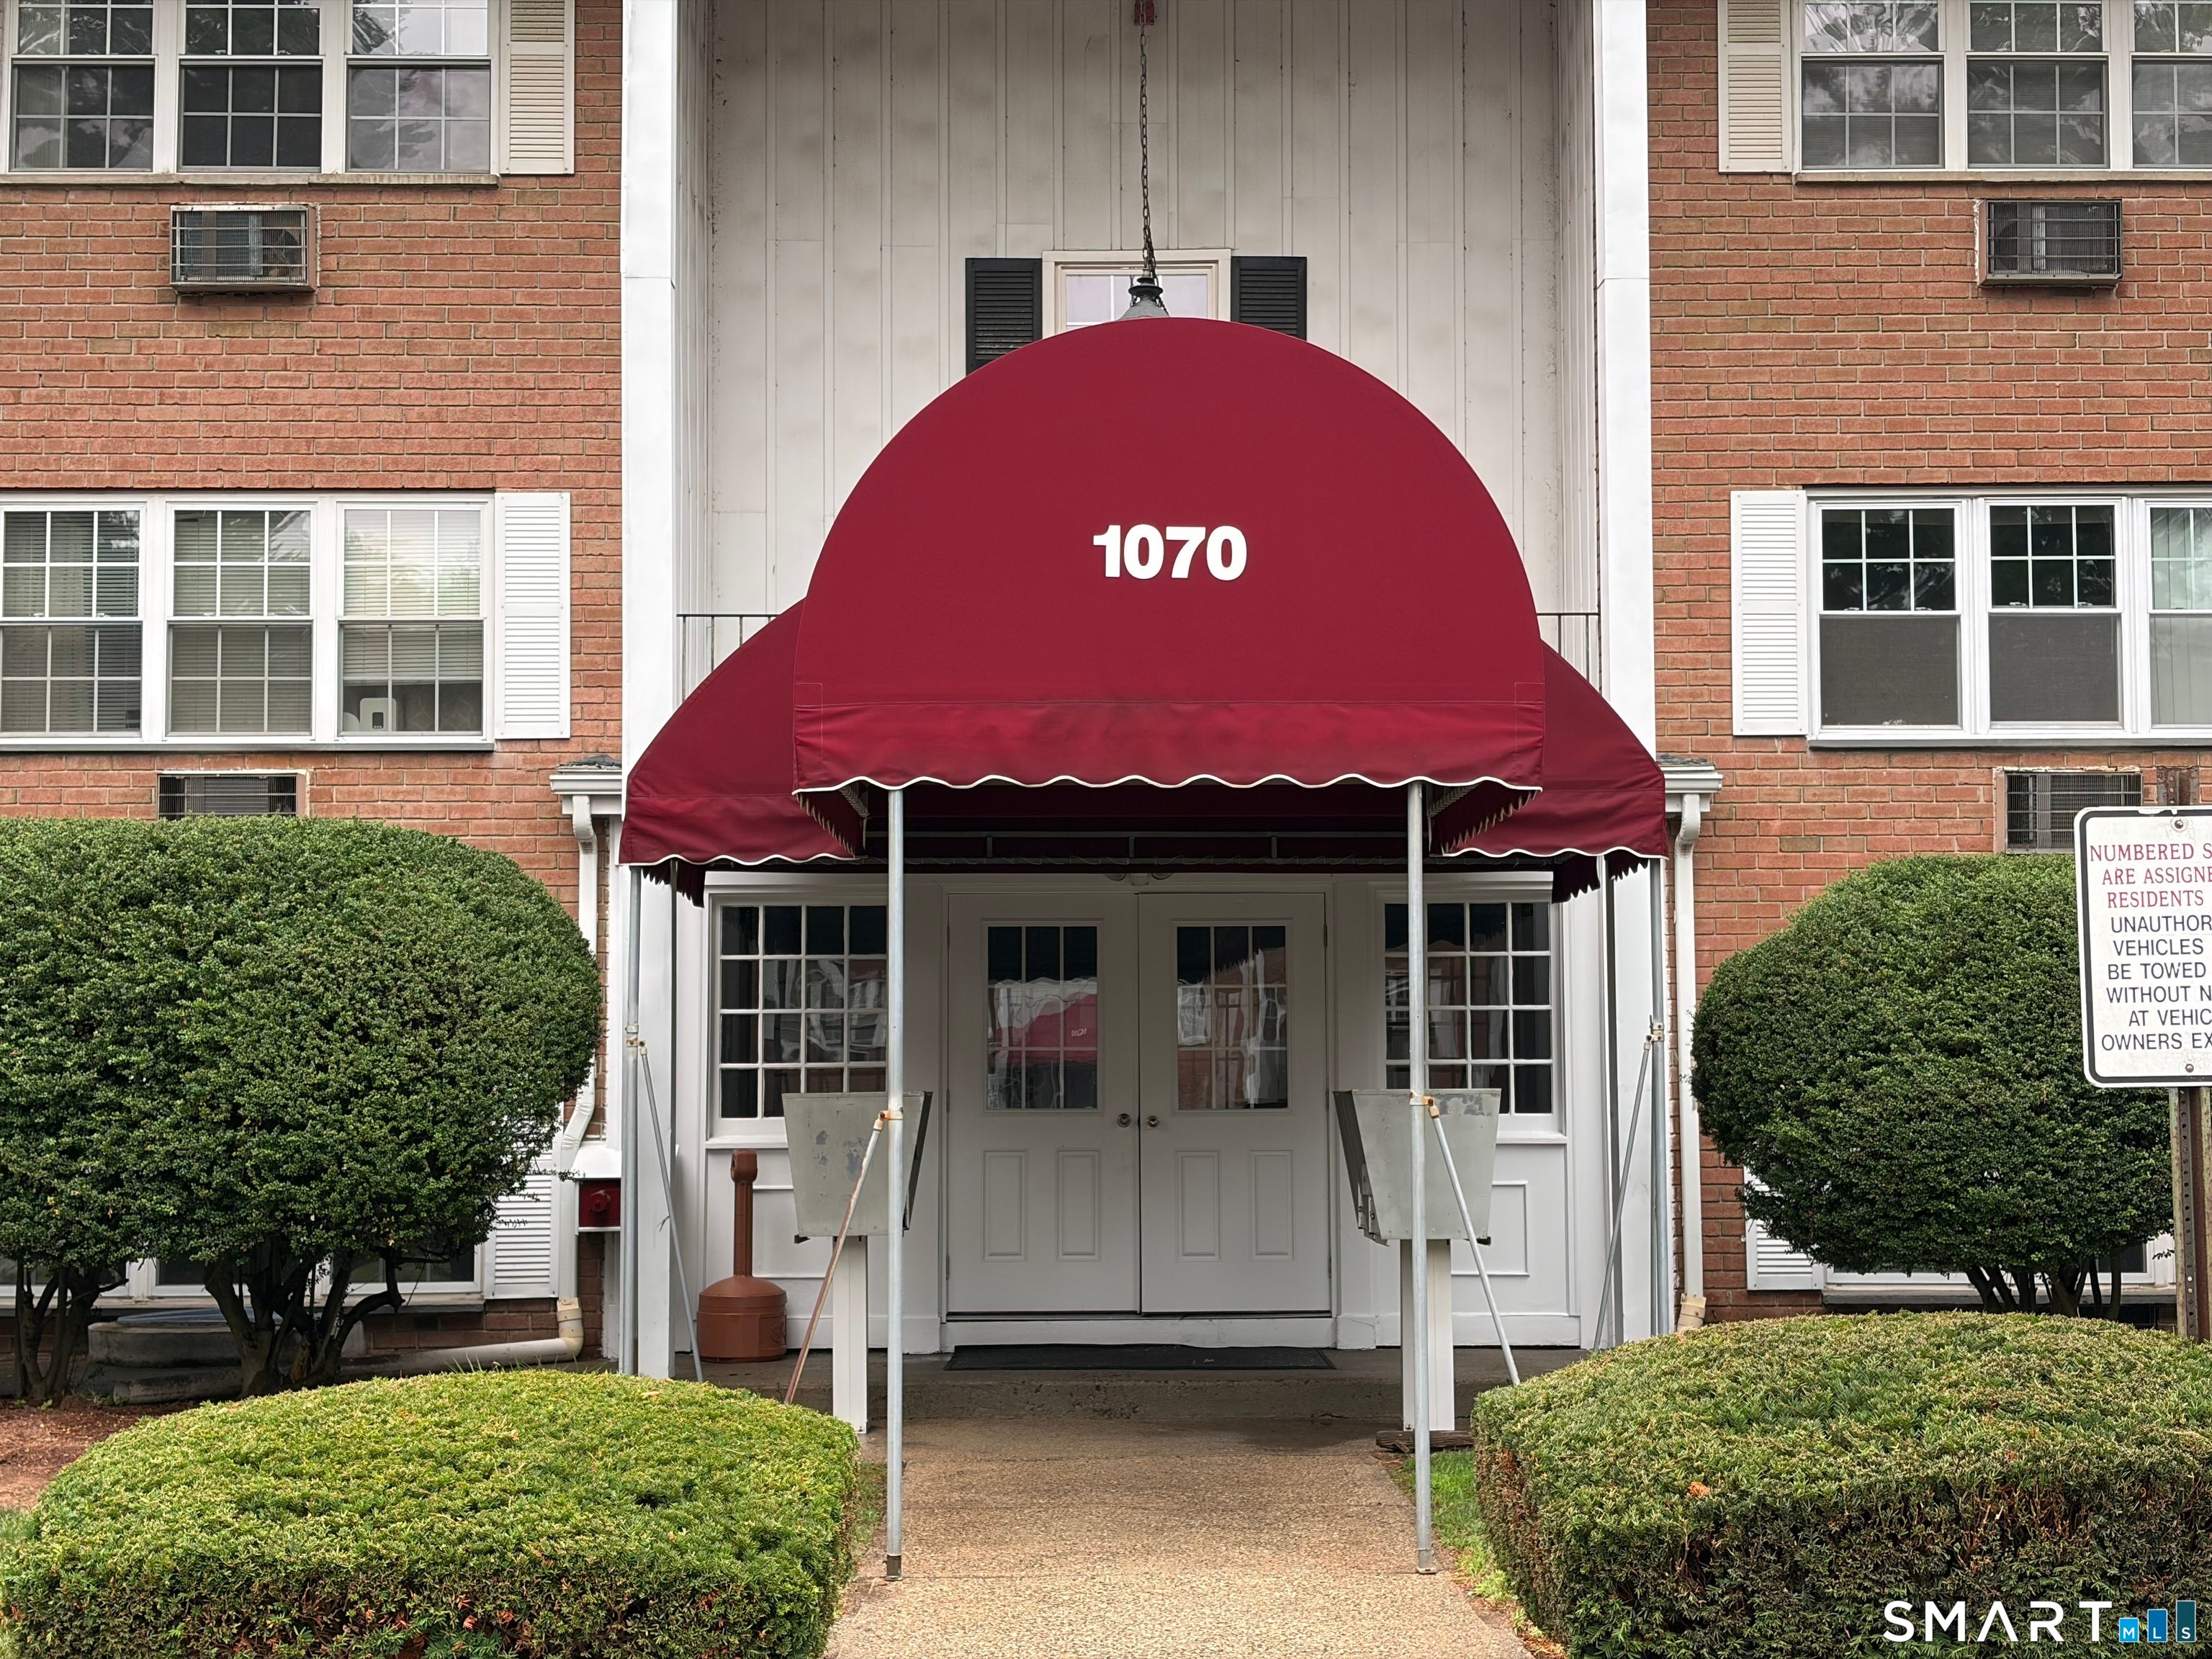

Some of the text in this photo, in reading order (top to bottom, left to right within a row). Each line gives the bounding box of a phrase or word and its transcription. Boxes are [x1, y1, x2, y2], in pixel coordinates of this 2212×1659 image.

[1093, 524, 1247, 580] 1070
[2090, 843, 2194, 862] NUMBERED
[2102, 868, 2136, 886] ARE
[2108, 890, 2203, 909] RESIDENTS
[2110, 915, 2212, 933] UNAUTHOR
[2113, 938, 2203, 956] VEHICLES
[2108, 962, 2207, 980] BE TOWED
[2106, 986, 2191, 1004] WITHOUT
[2128, 1008, 2212, 1027] AT VEHIC
[2102, 1033, 2212, 1051] OWNERS EX
